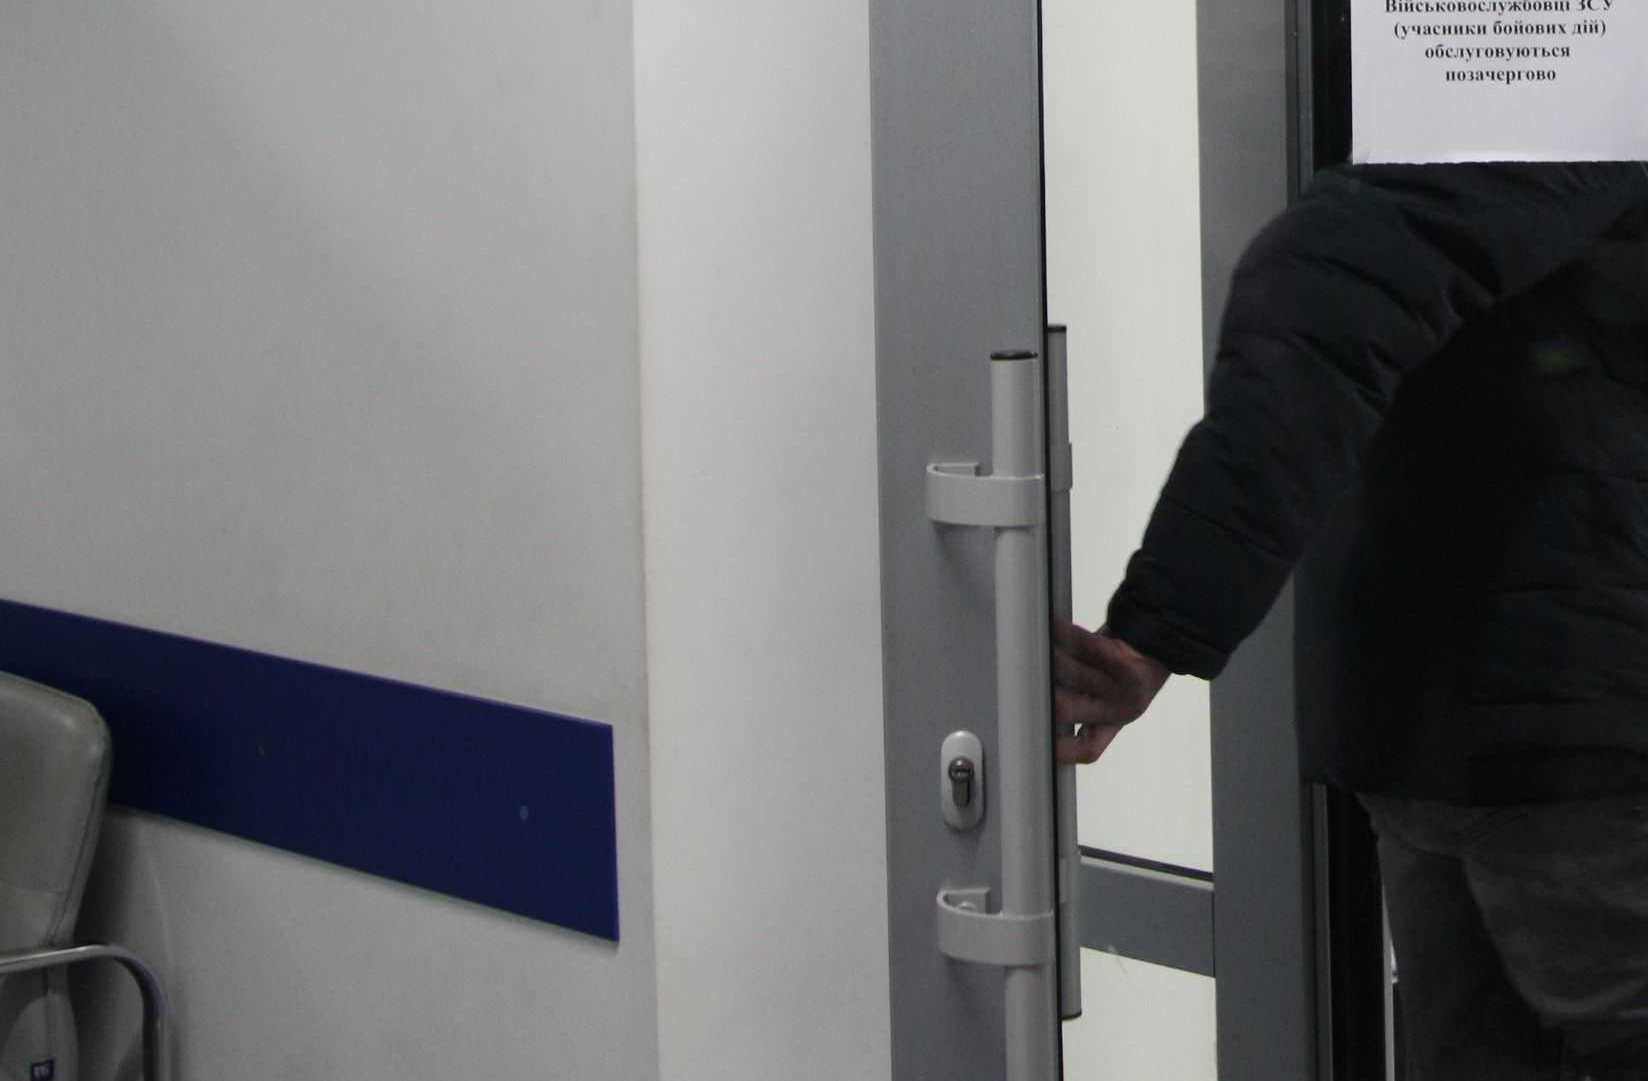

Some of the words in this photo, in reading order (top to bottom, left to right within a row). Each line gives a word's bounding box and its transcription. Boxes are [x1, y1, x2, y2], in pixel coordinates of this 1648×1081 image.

[1393, 22, 1488, 38] (учасники
[1492, 20, 1568, 36] бойових
[1572, 18, 1607, 36] дій)
[1424, 44, 1571, 61] обслуговуються
[1445, 69, 1557, 85] позачергово
